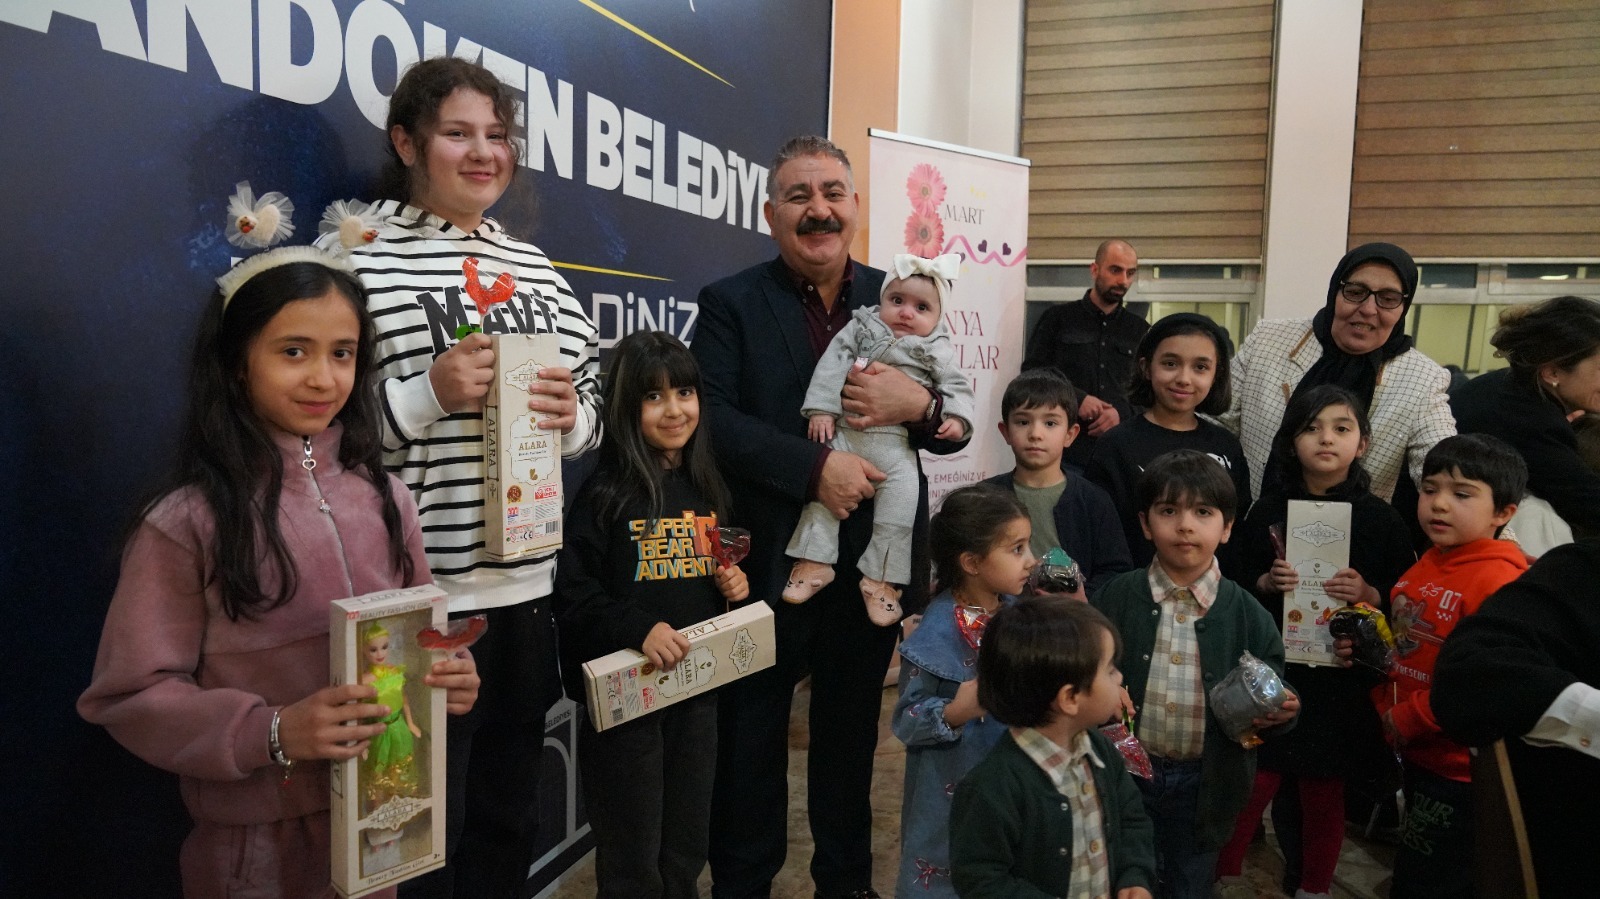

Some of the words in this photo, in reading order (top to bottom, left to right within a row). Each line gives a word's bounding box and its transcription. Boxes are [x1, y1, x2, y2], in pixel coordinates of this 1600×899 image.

[944, 204, 985, 226] MART
[487, 417, 496, 468] ALARA
[518, 440, 548, 451] ALARA
[977, 471, 987, 481] VE
[629, 518, 696, 541] SUPER
[637, 537, 695, 561] BEAR
[634, 556, 718, 582] ADVENT
[359, 610, 386, 620] BEAUTY
[386, 602, 416, 614] FASHION
[1438, 589, 1463, 612] 07
[684, 658, 693, 685] ALARA
